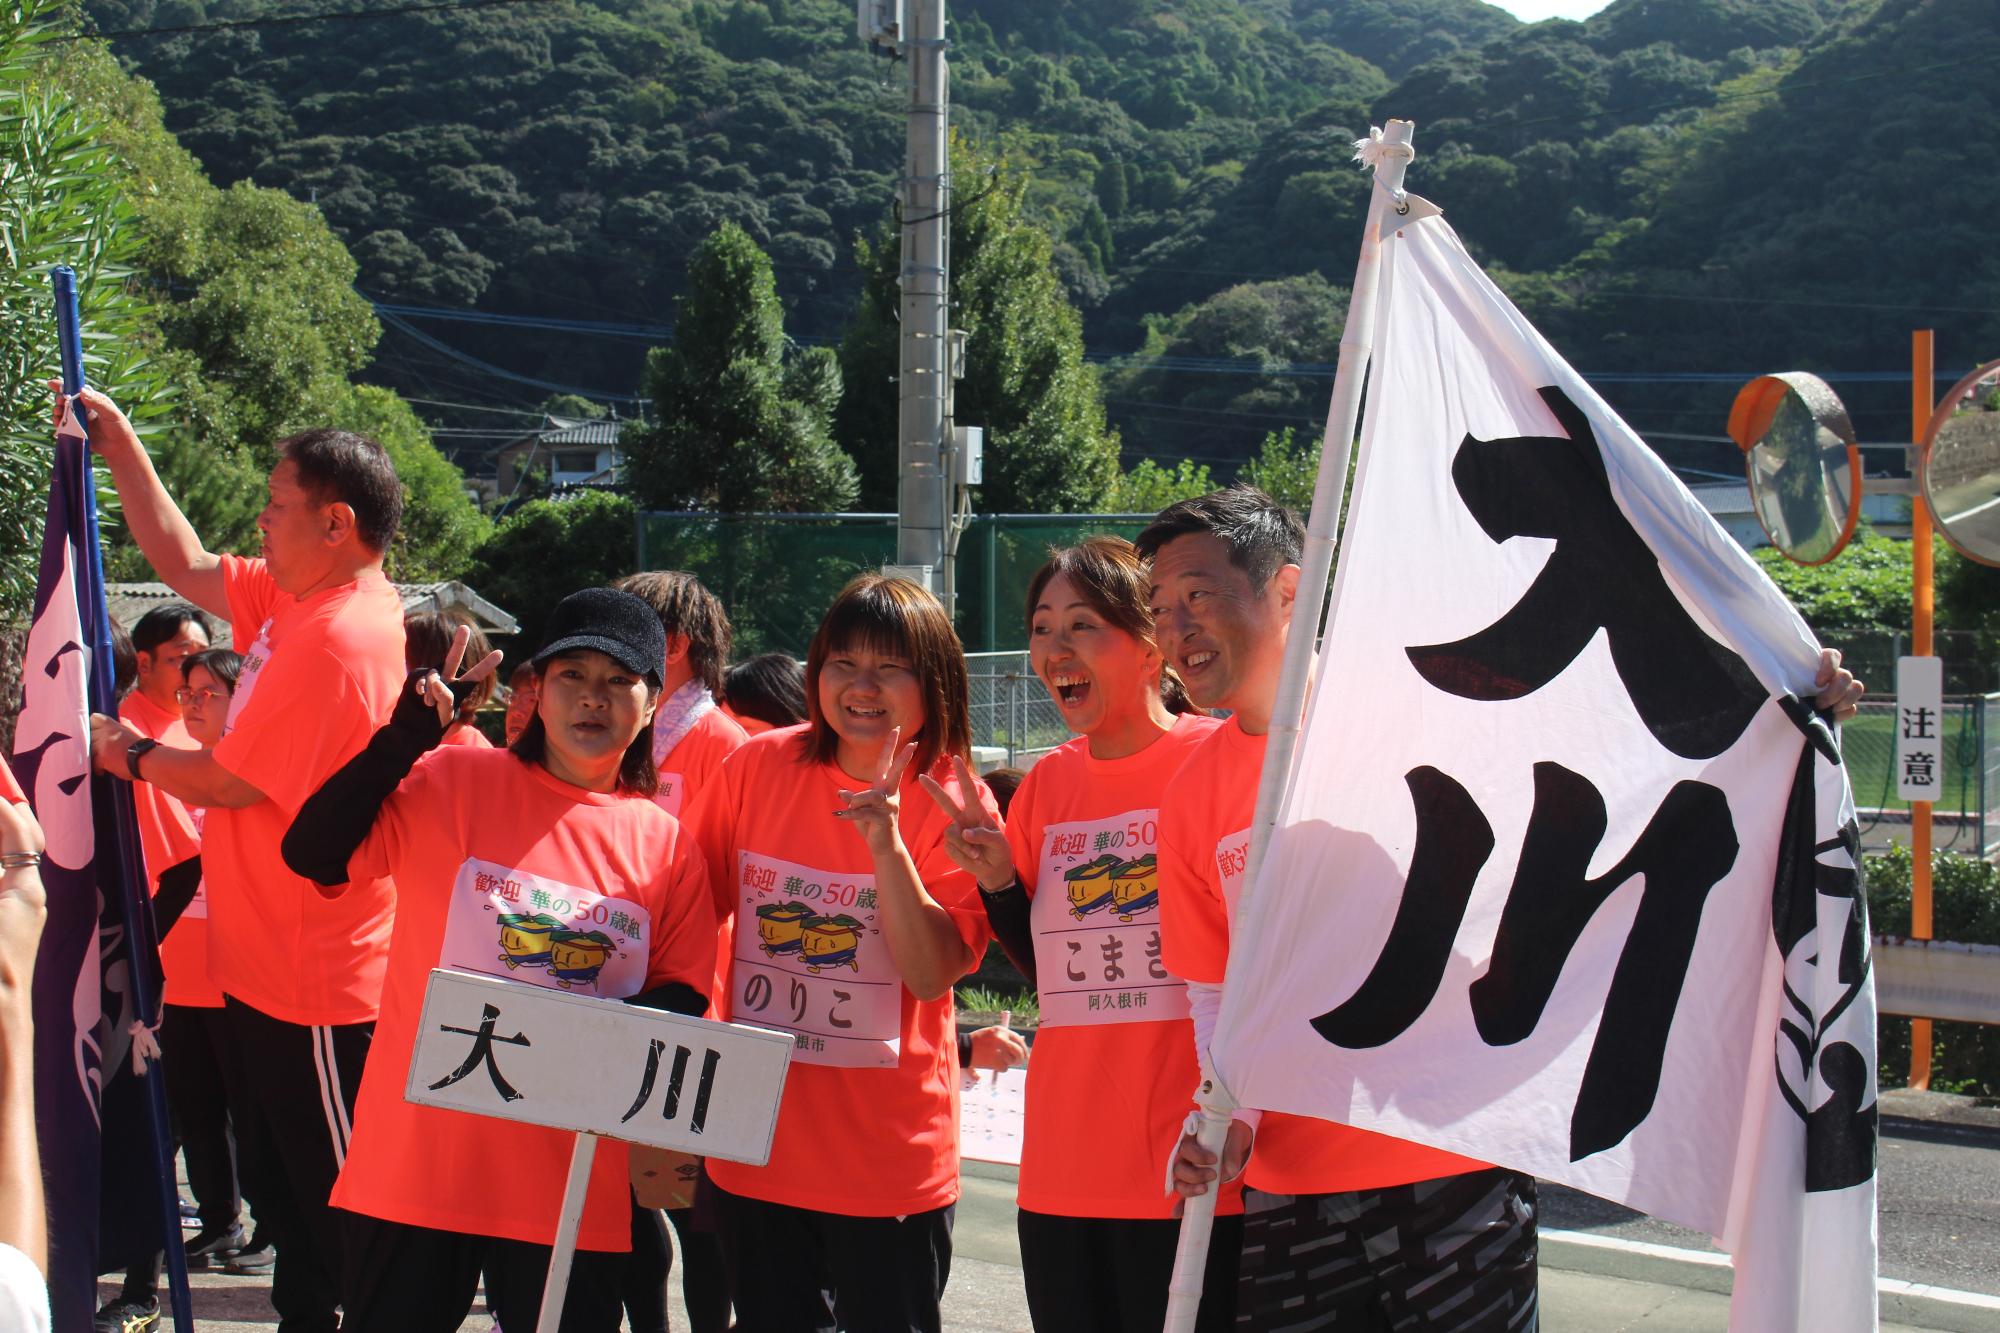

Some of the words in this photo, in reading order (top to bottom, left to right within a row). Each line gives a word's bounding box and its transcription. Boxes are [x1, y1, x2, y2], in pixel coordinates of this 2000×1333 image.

[1902, 707, 1935, 786] 注意
[1050, 832, 1088, 858] 歓迎
[474, 871, 523, 903] 歓迎
[529, 888, 643, 942] 華の50歳組
[742, 863, 777, 894] 歓迎
[782, 875, 881, 911] 華の50歳
[743, 973, 853, 1029] のりこ
[1087, 991, 1149, 1012] 阿久根市
